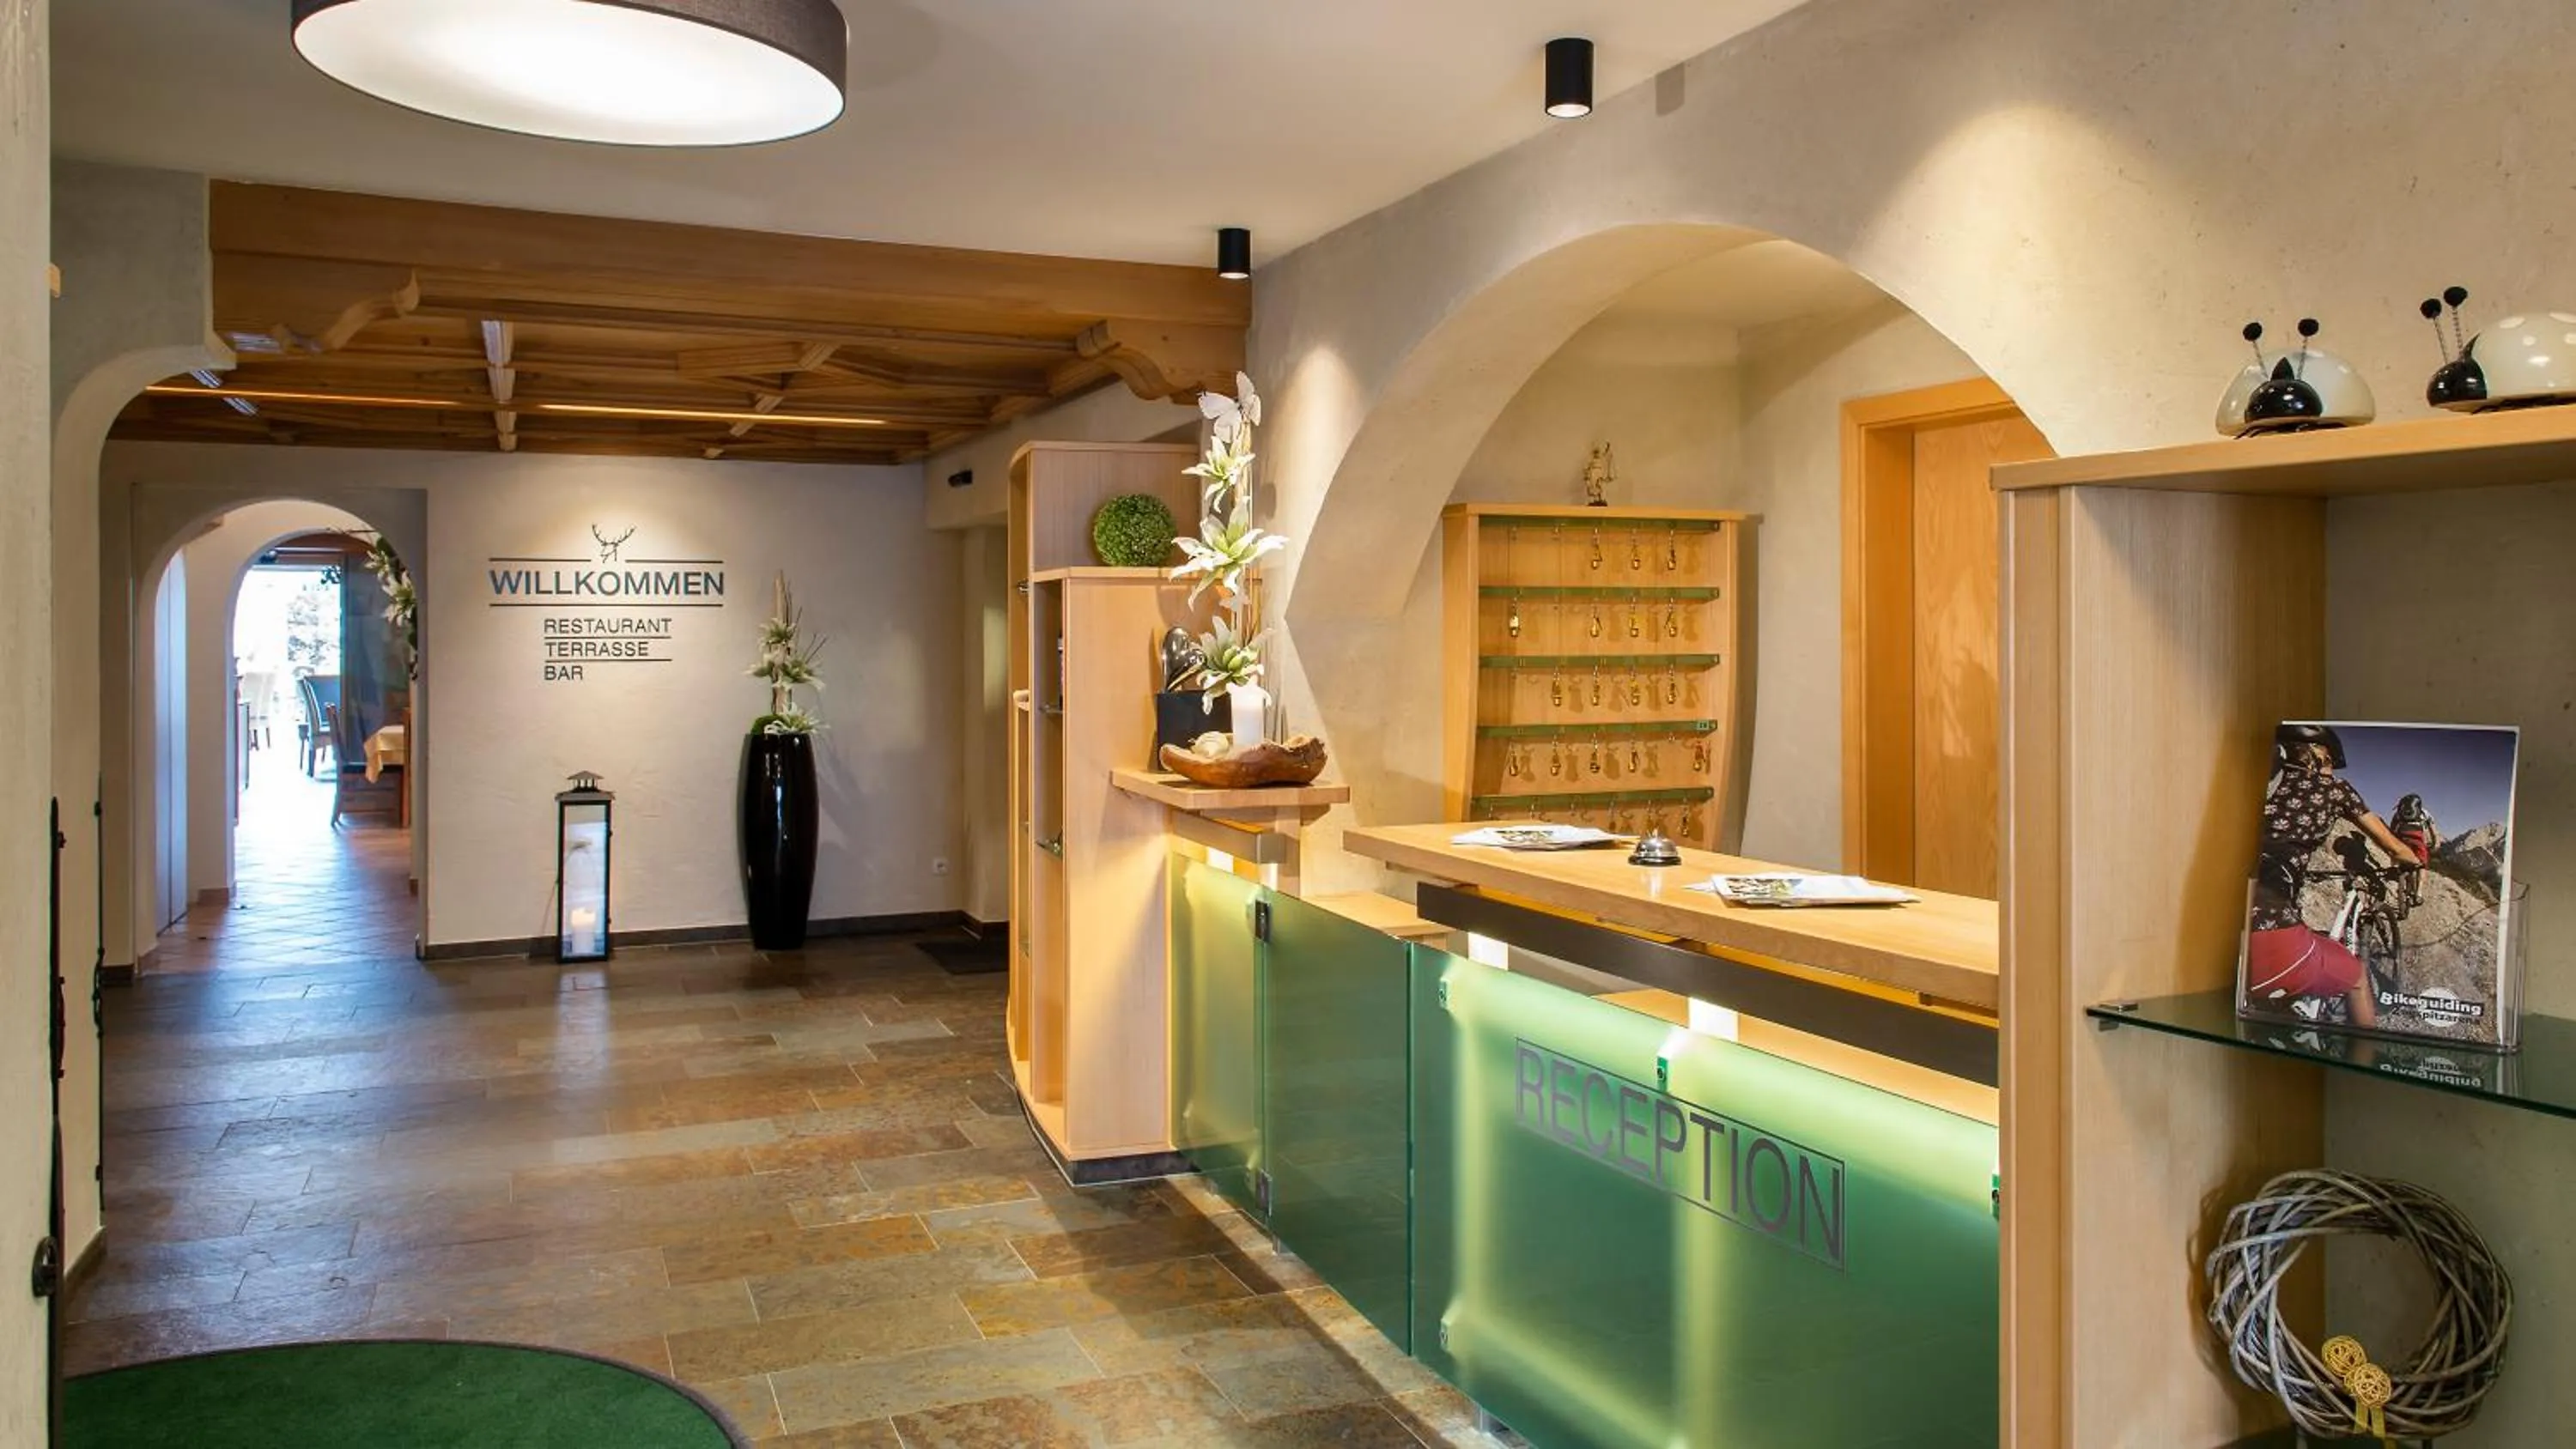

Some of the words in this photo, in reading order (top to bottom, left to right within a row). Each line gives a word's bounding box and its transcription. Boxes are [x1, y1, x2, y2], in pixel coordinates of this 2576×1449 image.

[489, 570, 725, 596] WILLKOMMEN
[544, 618, 672, 634] RESTAURANT
[544, 641, 648, 658] TERRASSE
[544, 665, 584, 681] BAR
[2379, 991, 2482, 1016] Bikeguiding
[1518, 1046, 1840, 1260] RECEPTION
